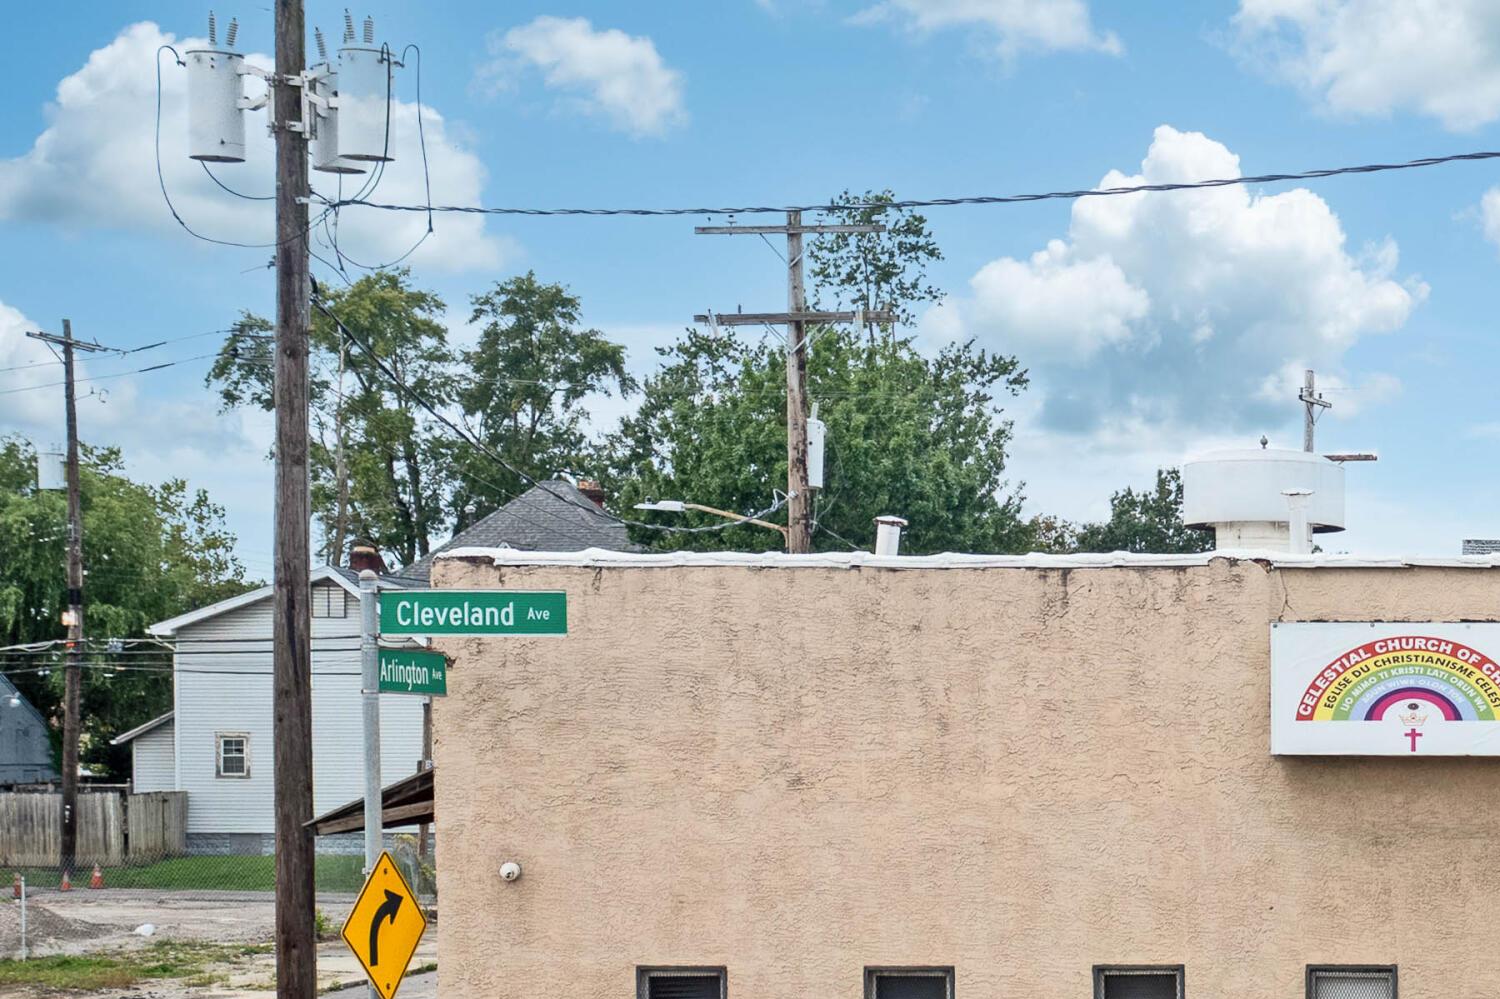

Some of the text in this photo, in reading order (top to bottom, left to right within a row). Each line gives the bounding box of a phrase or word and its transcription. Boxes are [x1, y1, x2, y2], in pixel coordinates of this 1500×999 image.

[396, 601, 550, 626] Cleveland Ave
[380, 657, 443, 691] Arlington Ave
[1298, 648, 1372, 716] CELESTIAL
[1374, 638, 1454, 655] CHURCH
[1457, 648, 1482, 665] OF
[1323, 677, 1353, 709] EGLISE
[1351, 664, 1371, 679] DU
[1373, 654, 1476, 679] CHRISTIANISME
